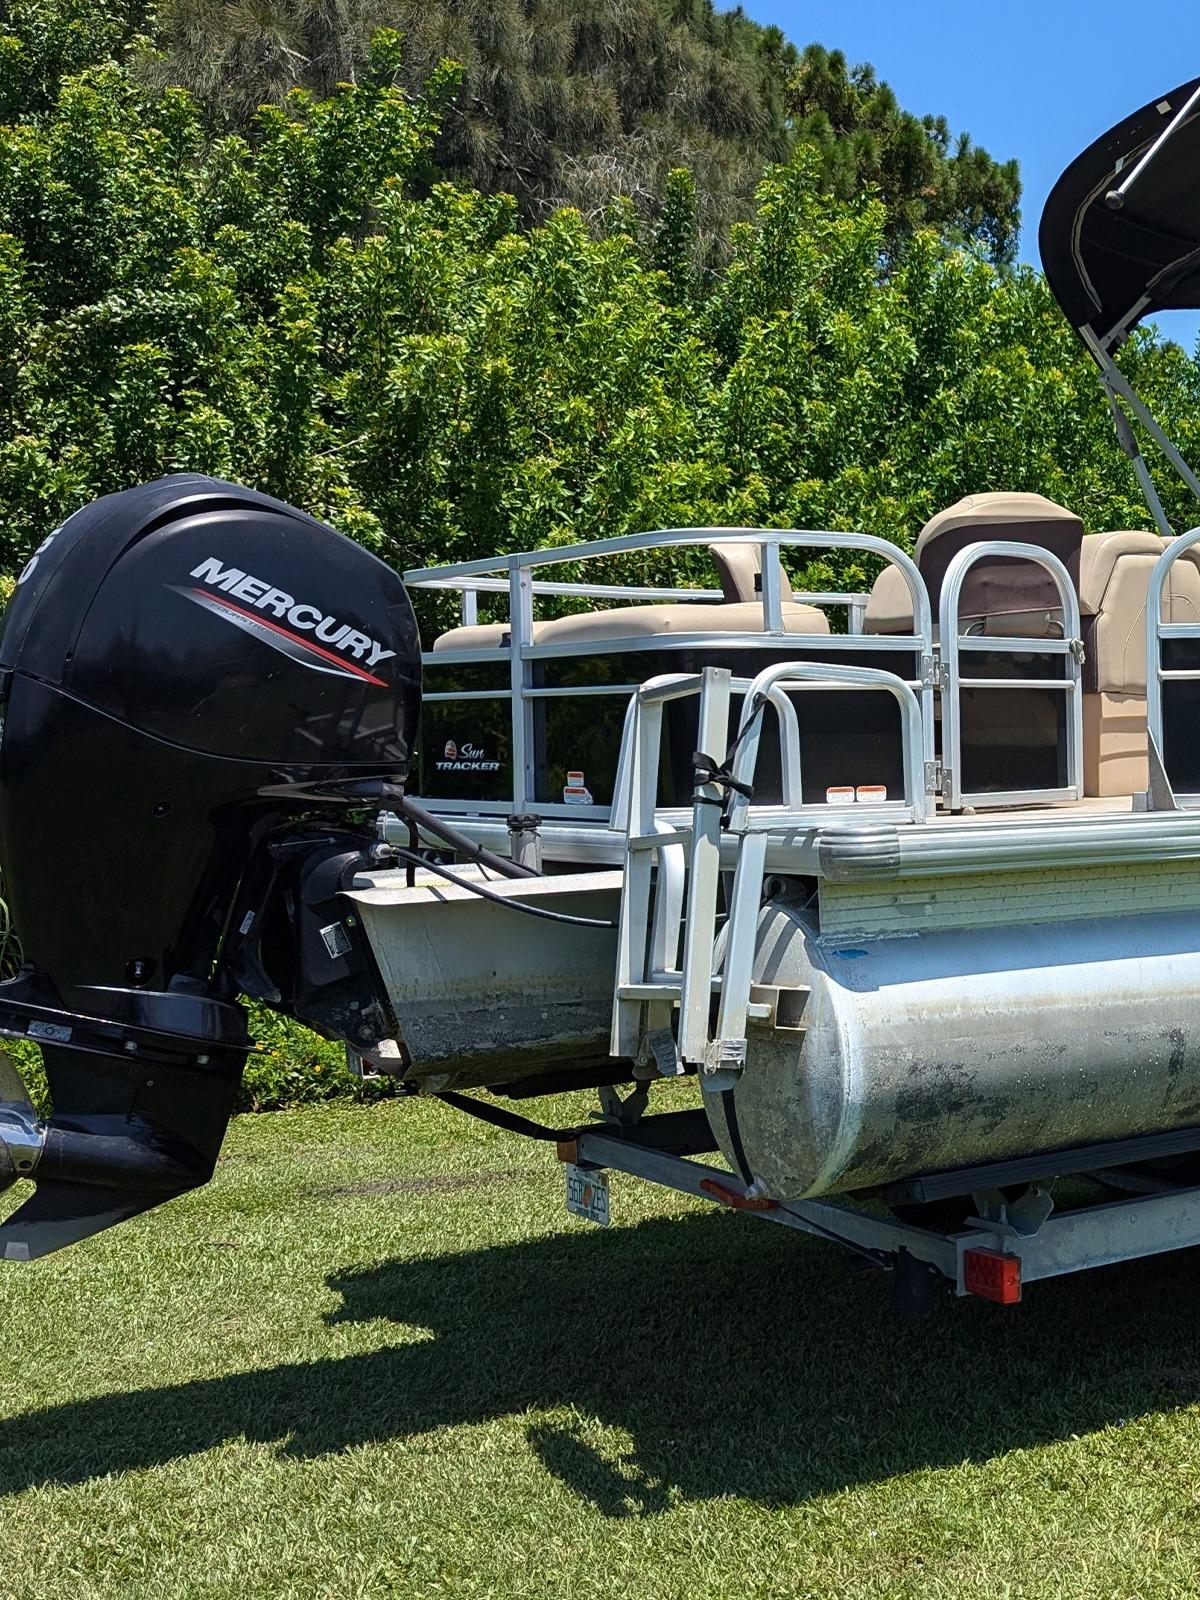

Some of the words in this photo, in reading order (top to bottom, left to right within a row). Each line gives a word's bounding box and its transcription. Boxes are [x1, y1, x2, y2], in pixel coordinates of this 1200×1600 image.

[190, 556, 397, 667] MERCURY
[458, 743, 485, 760] Sun
[435, 762, 500, 771] TRACKER
